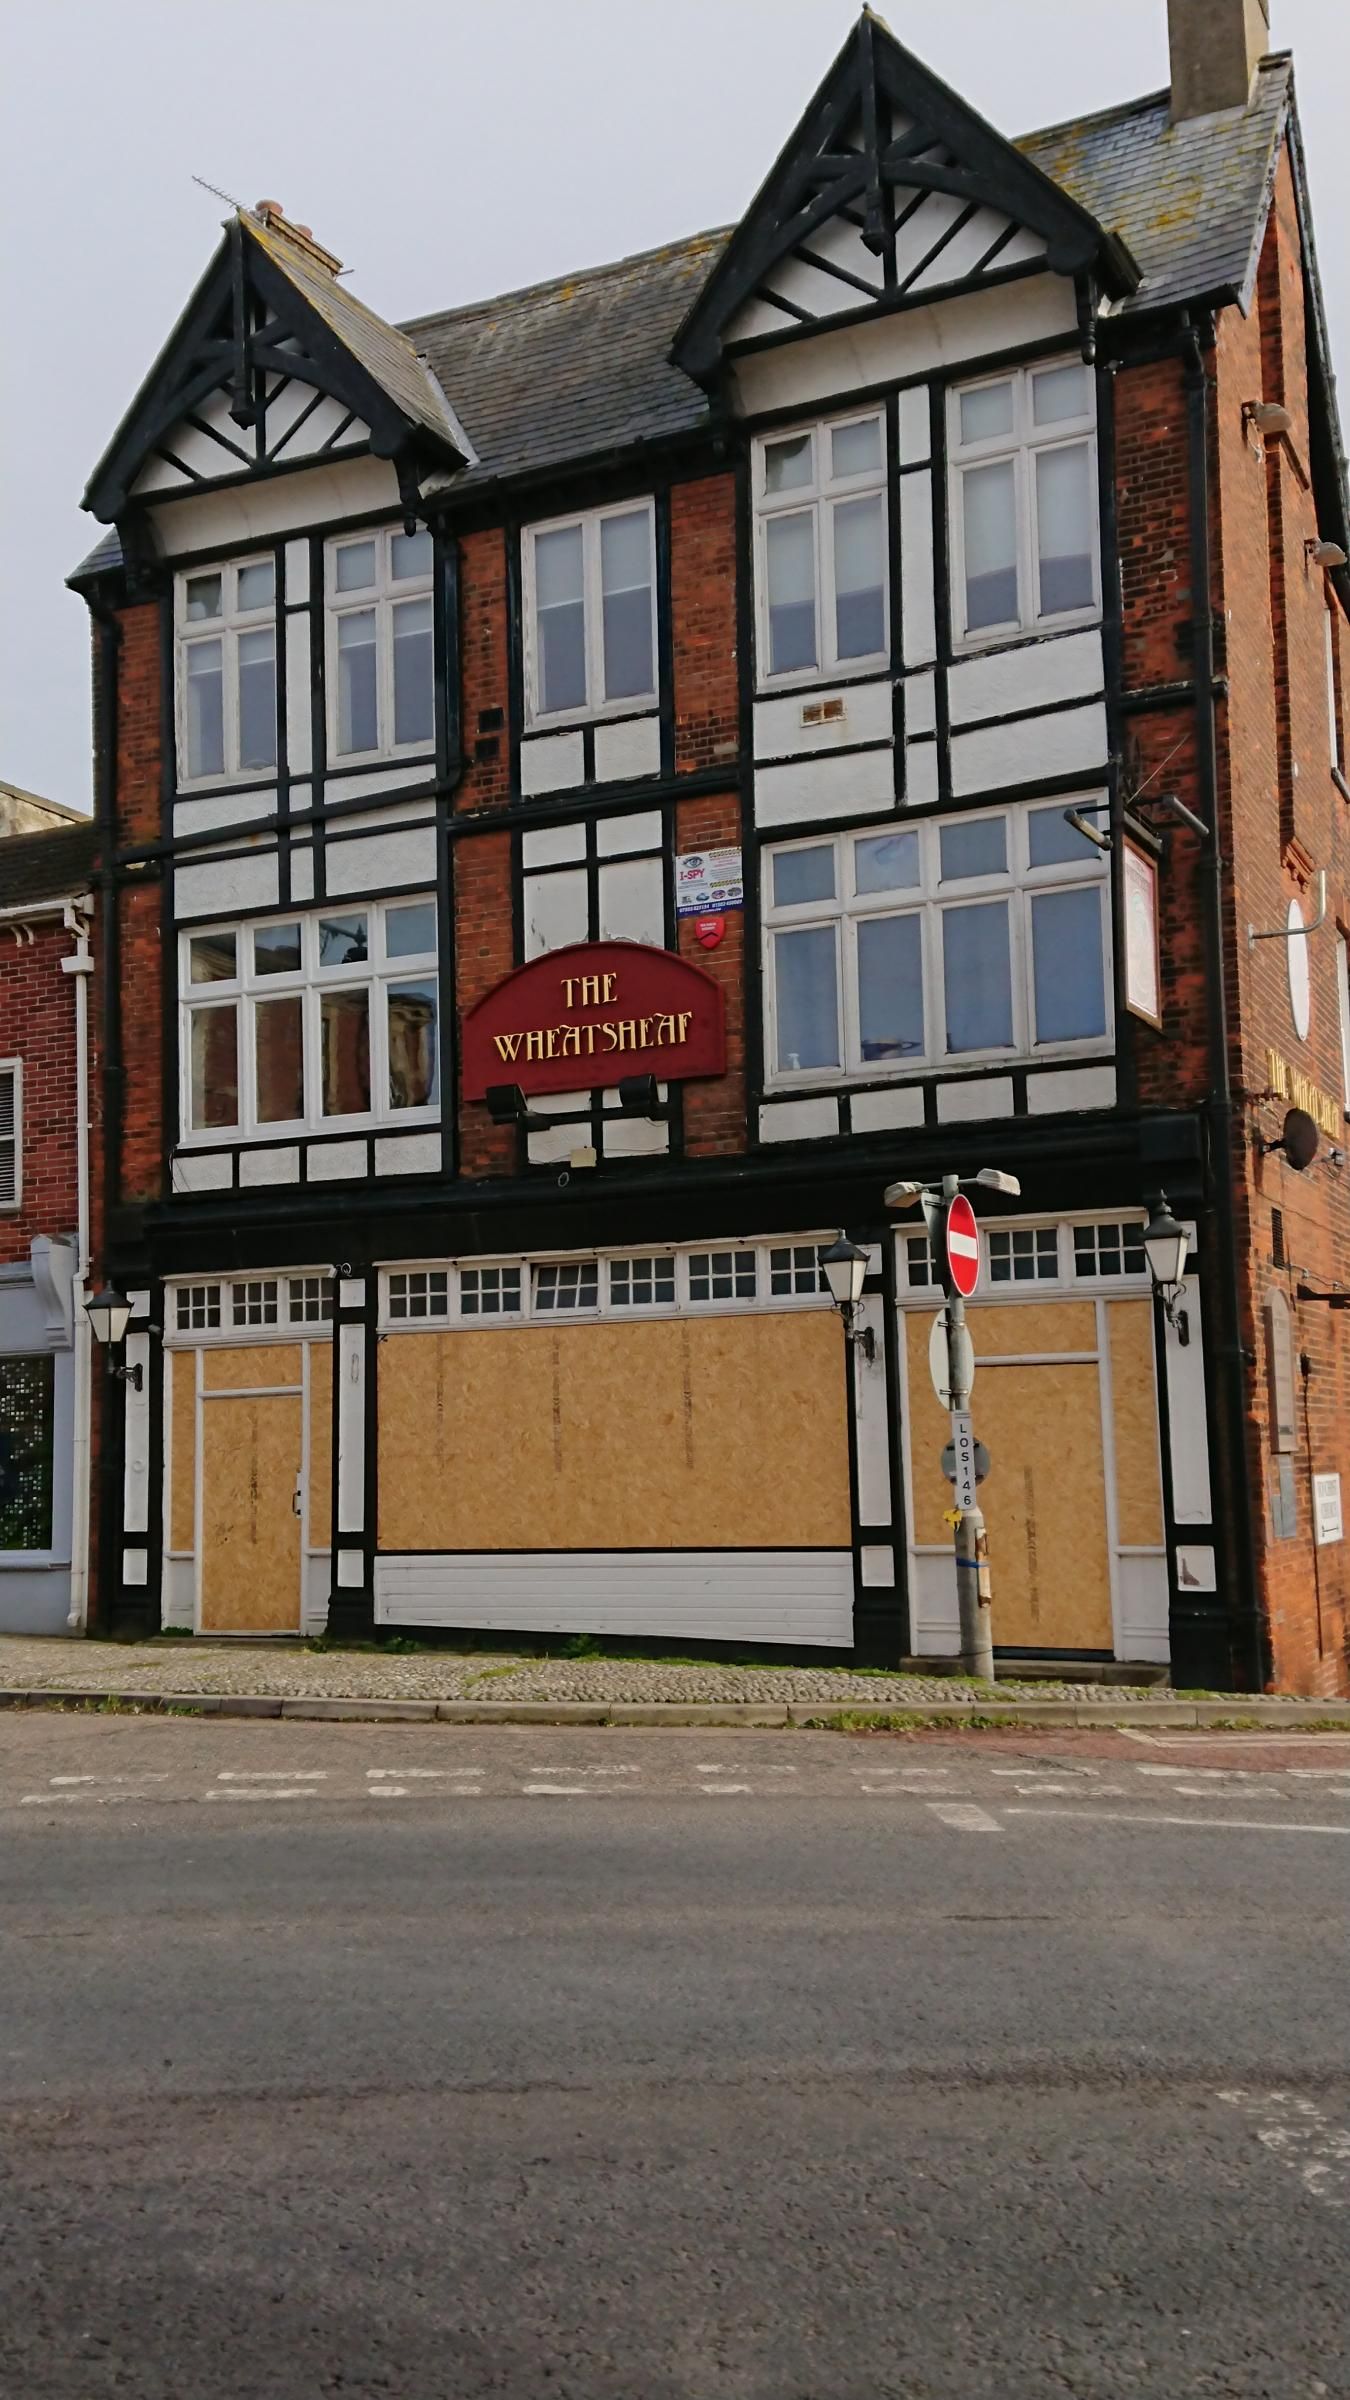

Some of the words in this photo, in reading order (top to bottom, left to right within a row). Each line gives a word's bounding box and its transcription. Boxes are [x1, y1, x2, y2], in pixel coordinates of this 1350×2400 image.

[680, 868, 705, 880] I-SPY
[560, 972, 617, 1008] THE
[494, 1011, 693, 1062] WHEATSHEAF
